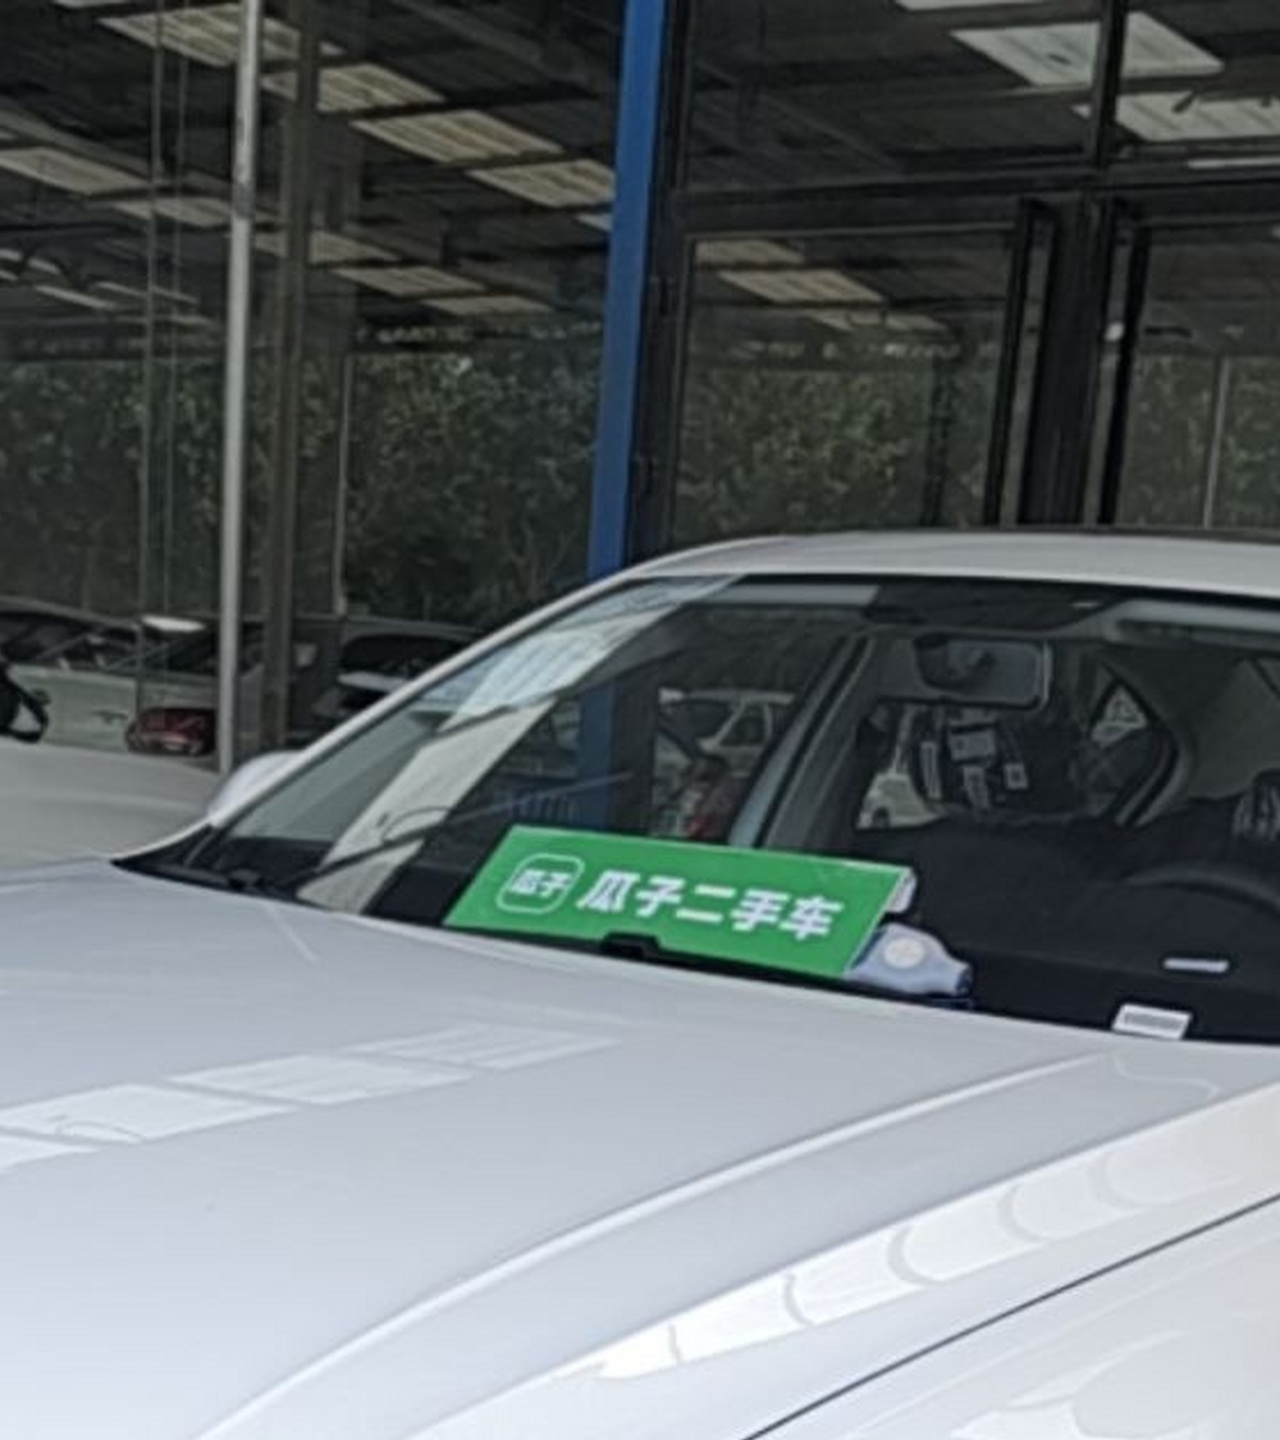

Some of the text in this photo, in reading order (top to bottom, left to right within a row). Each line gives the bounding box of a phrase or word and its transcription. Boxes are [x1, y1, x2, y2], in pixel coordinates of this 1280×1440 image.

[509, 868, 572, 898] 瓜子
[576, 869, 844, 940] 瓜子二手车
